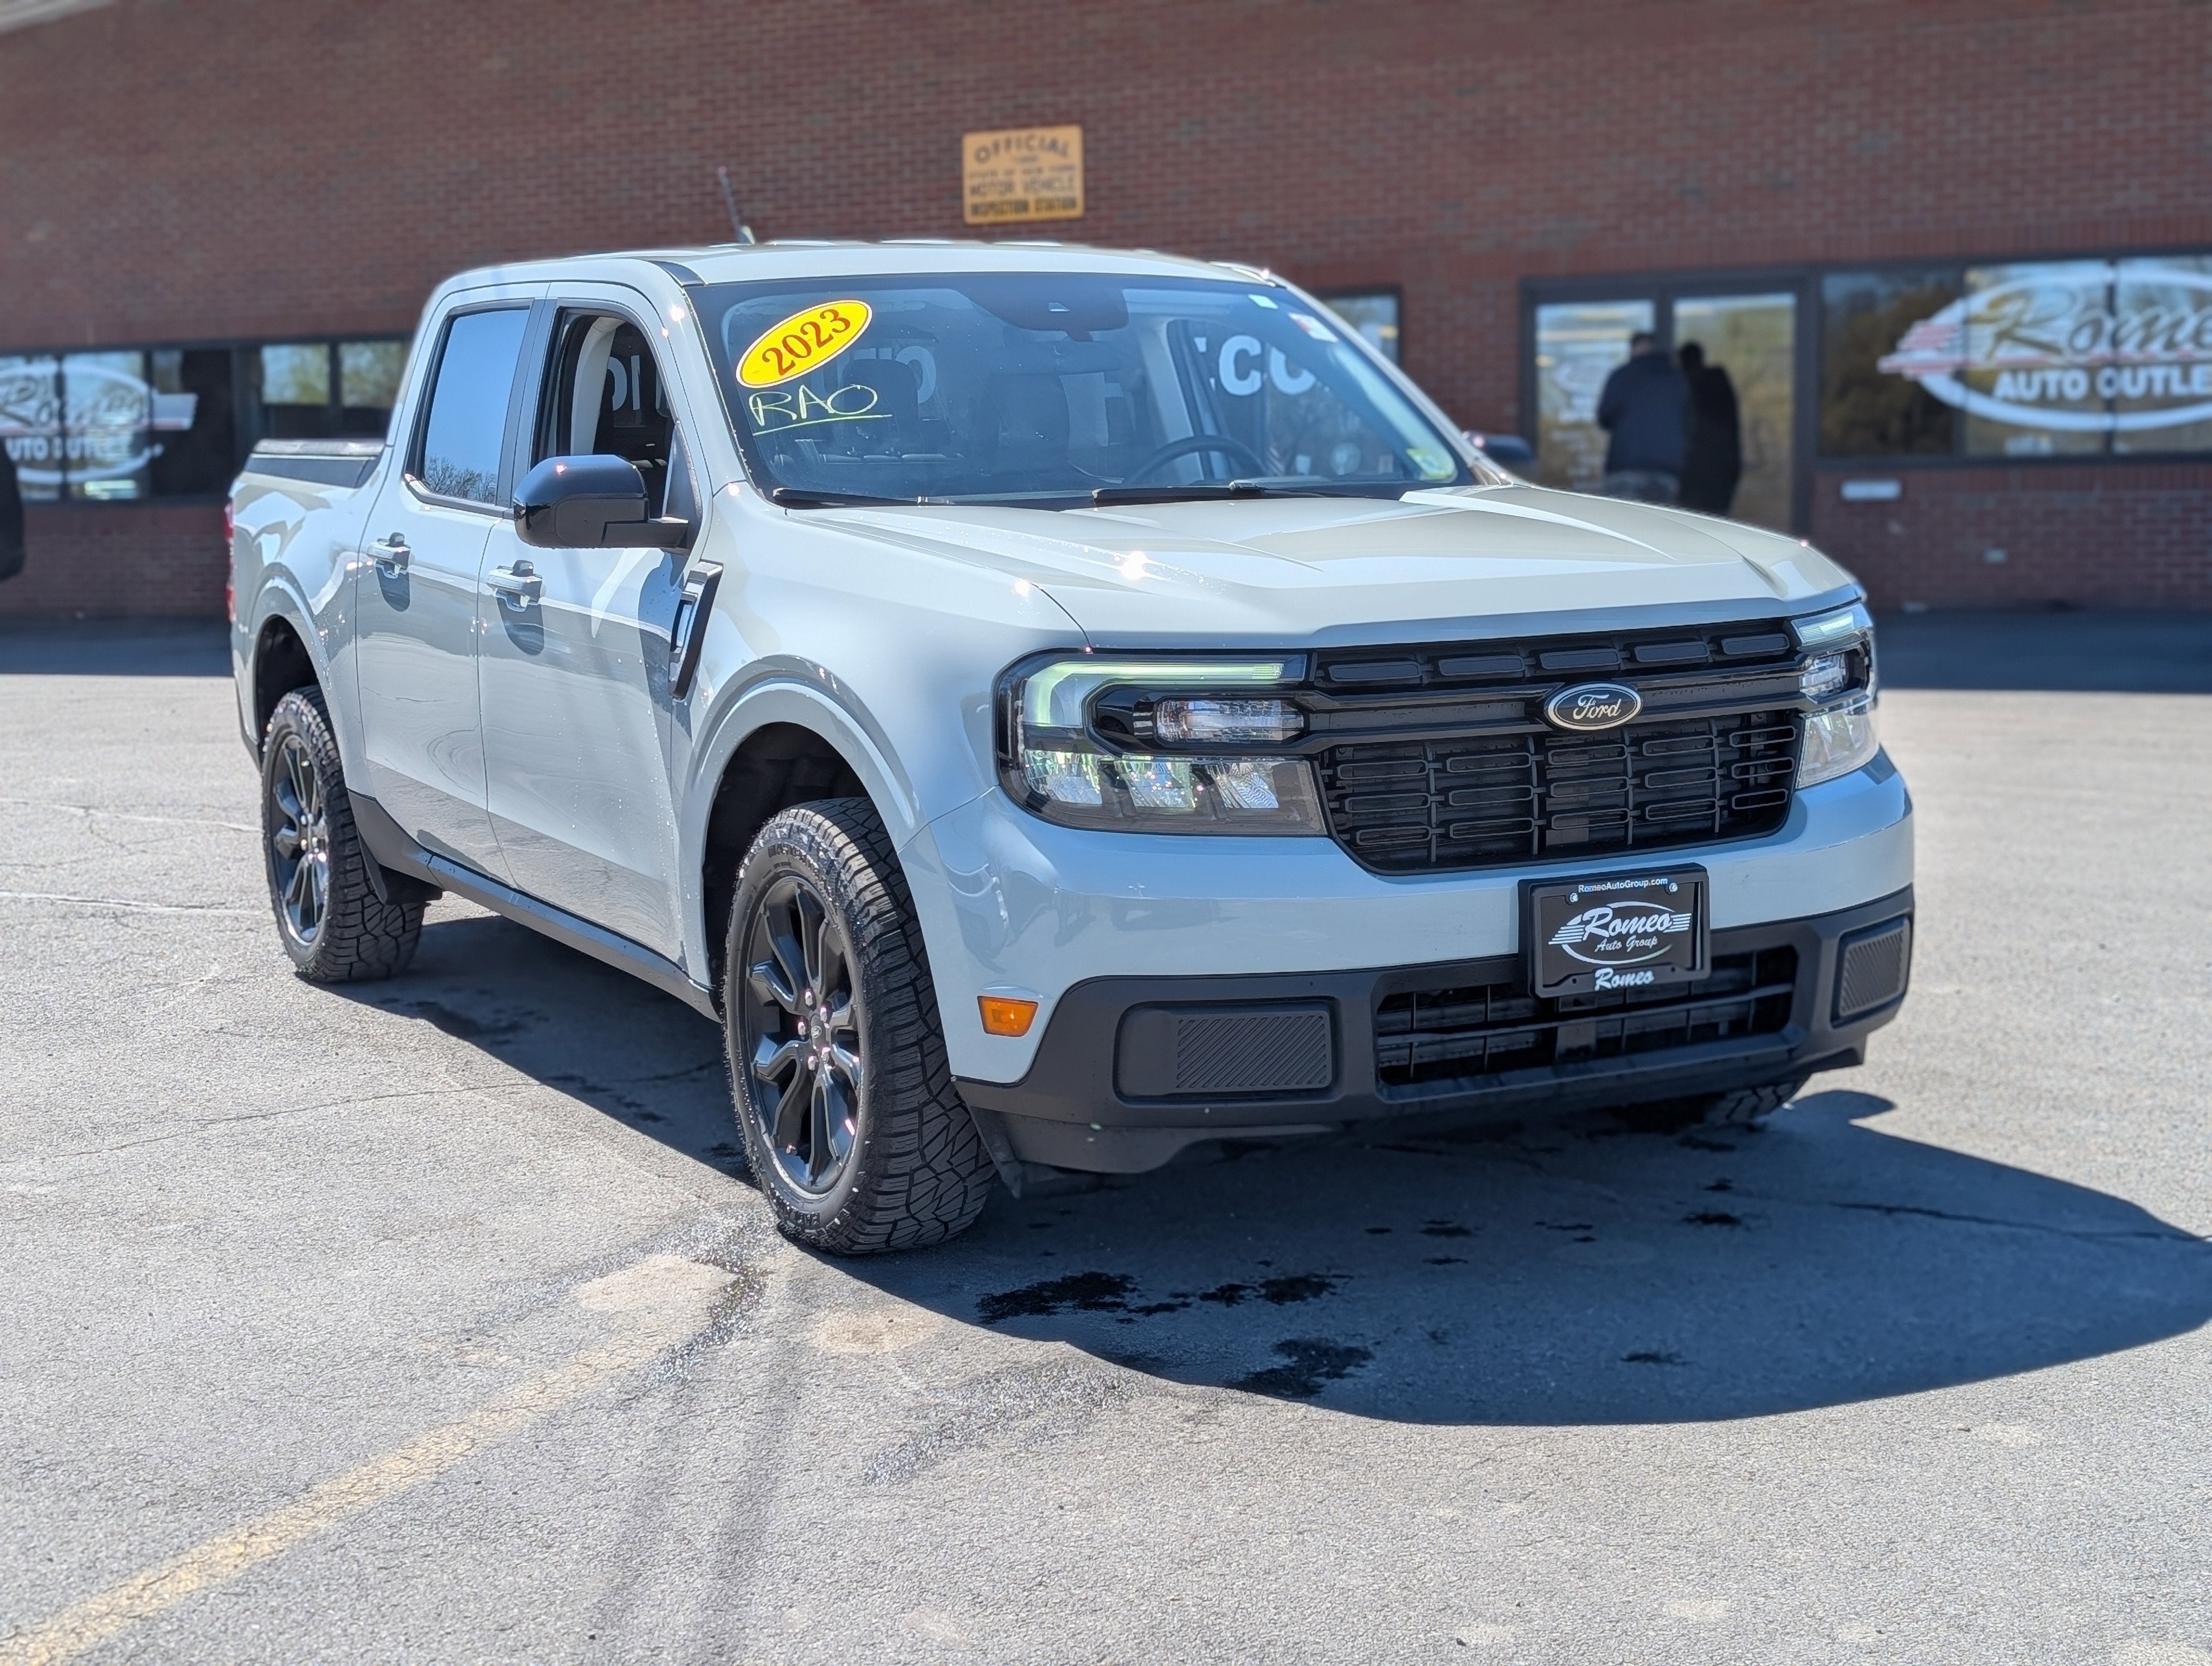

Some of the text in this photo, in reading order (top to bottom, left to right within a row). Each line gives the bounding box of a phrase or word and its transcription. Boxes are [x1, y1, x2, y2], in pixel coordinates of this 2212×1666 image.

[762, 308, 851, 376] 2023
[1992, 369, 2089, 401] AUTO
[749, 384, 878, 426] RAO
[1573, 694, 1622, 720] Ford
[1578, 878, 1668, 893] RomeoAutoGroup.com
[1581, 906, 1673, 941] Romeo
[1594, 935, 1658, 953] Auto Group
[1594, 967, 1654, 991] Romeo
